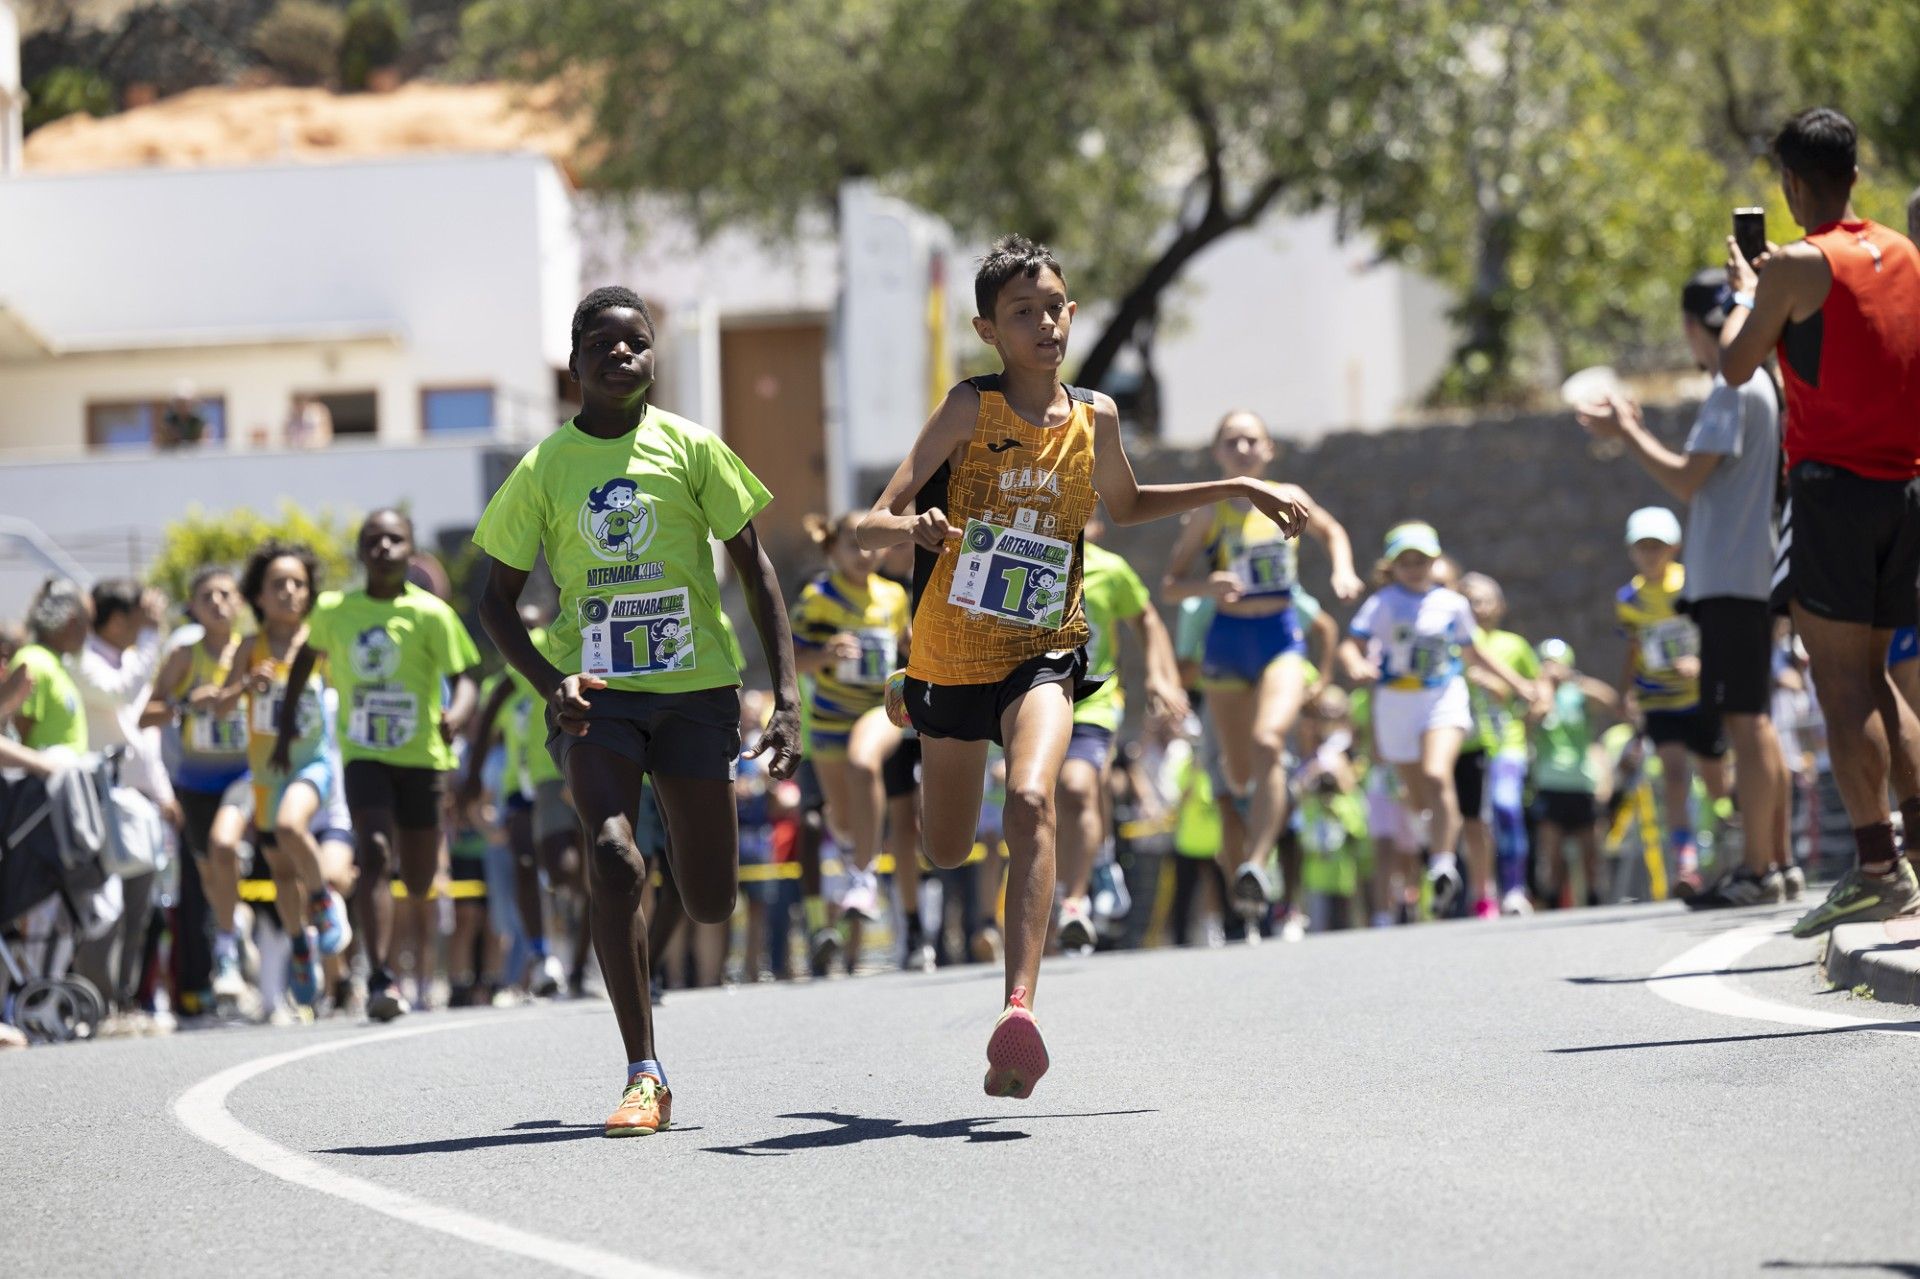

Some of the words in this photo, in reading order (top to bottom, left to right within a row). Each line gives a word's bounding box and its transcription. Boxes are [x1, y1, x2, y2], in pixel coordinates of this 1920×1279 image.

[1001, 566, 1029, 612] 1
[623, 625, 651, 668] 1
[373, 716, 388, 743] 1
